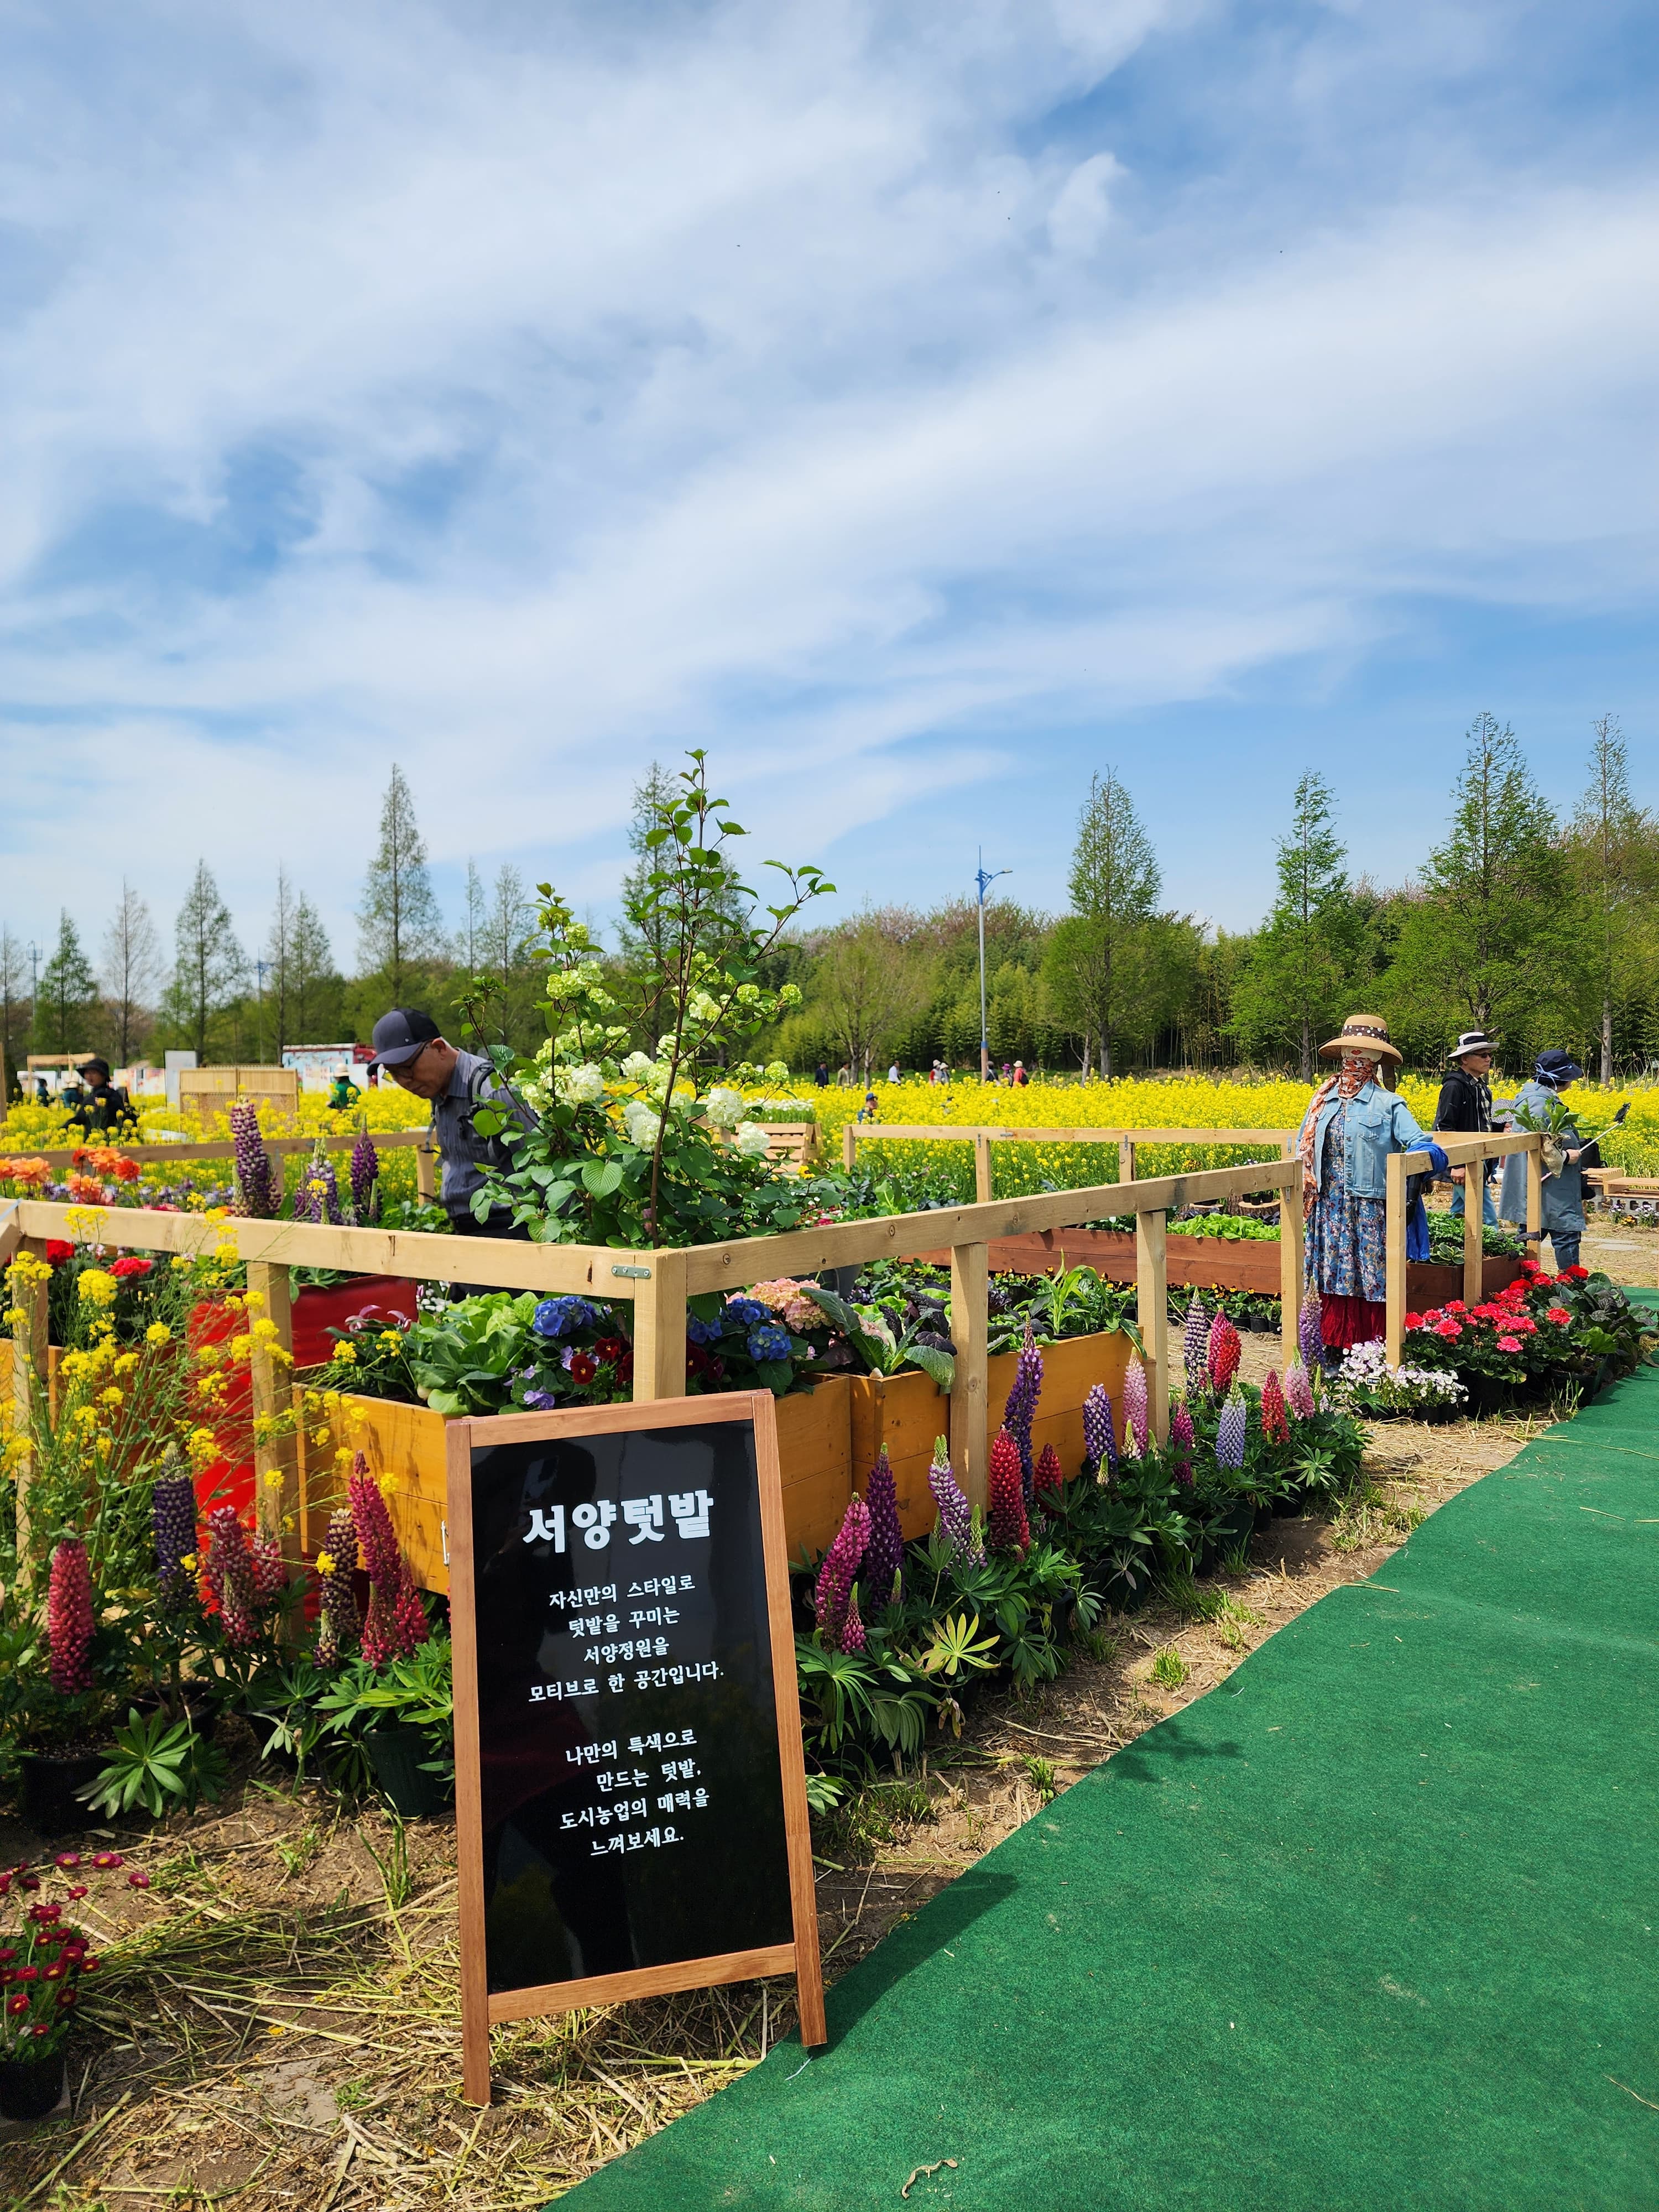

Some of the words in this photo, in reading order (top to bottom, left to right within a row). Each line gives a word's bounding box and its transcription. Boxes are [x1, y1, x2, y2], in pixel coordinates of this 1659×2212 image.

[522, 1489, 714, 1553] 서양텃밭
[549, 1583, 617, 1610] 자신만의
[627, 1574, 696, 1598] 스타일로
[568, 1614, 620, 1639] 텃밭을
[628, 1606, 680, 1629] 꾸미는
[583, 1636, 670, 1665] 서양정원을
[528, 1678, 599, 1702] 모티브로
[607, 1673, 625, 1693] 한
[633, 1661, 724, 1690] 공간입니다.
[565, 1740, 617, 1766] 나만의
[627, 1729, 697, 1756] 특색으로
[596, 1768, 650, 1792] 만드는
[661, 1758, 701, 1782] 텃밭,
[559, 1797, 647, 1829] 도시농업의
[656, 1787, 710, 1813] 매력을
[590, 1827, 684, 1856] 느껴보세요.
